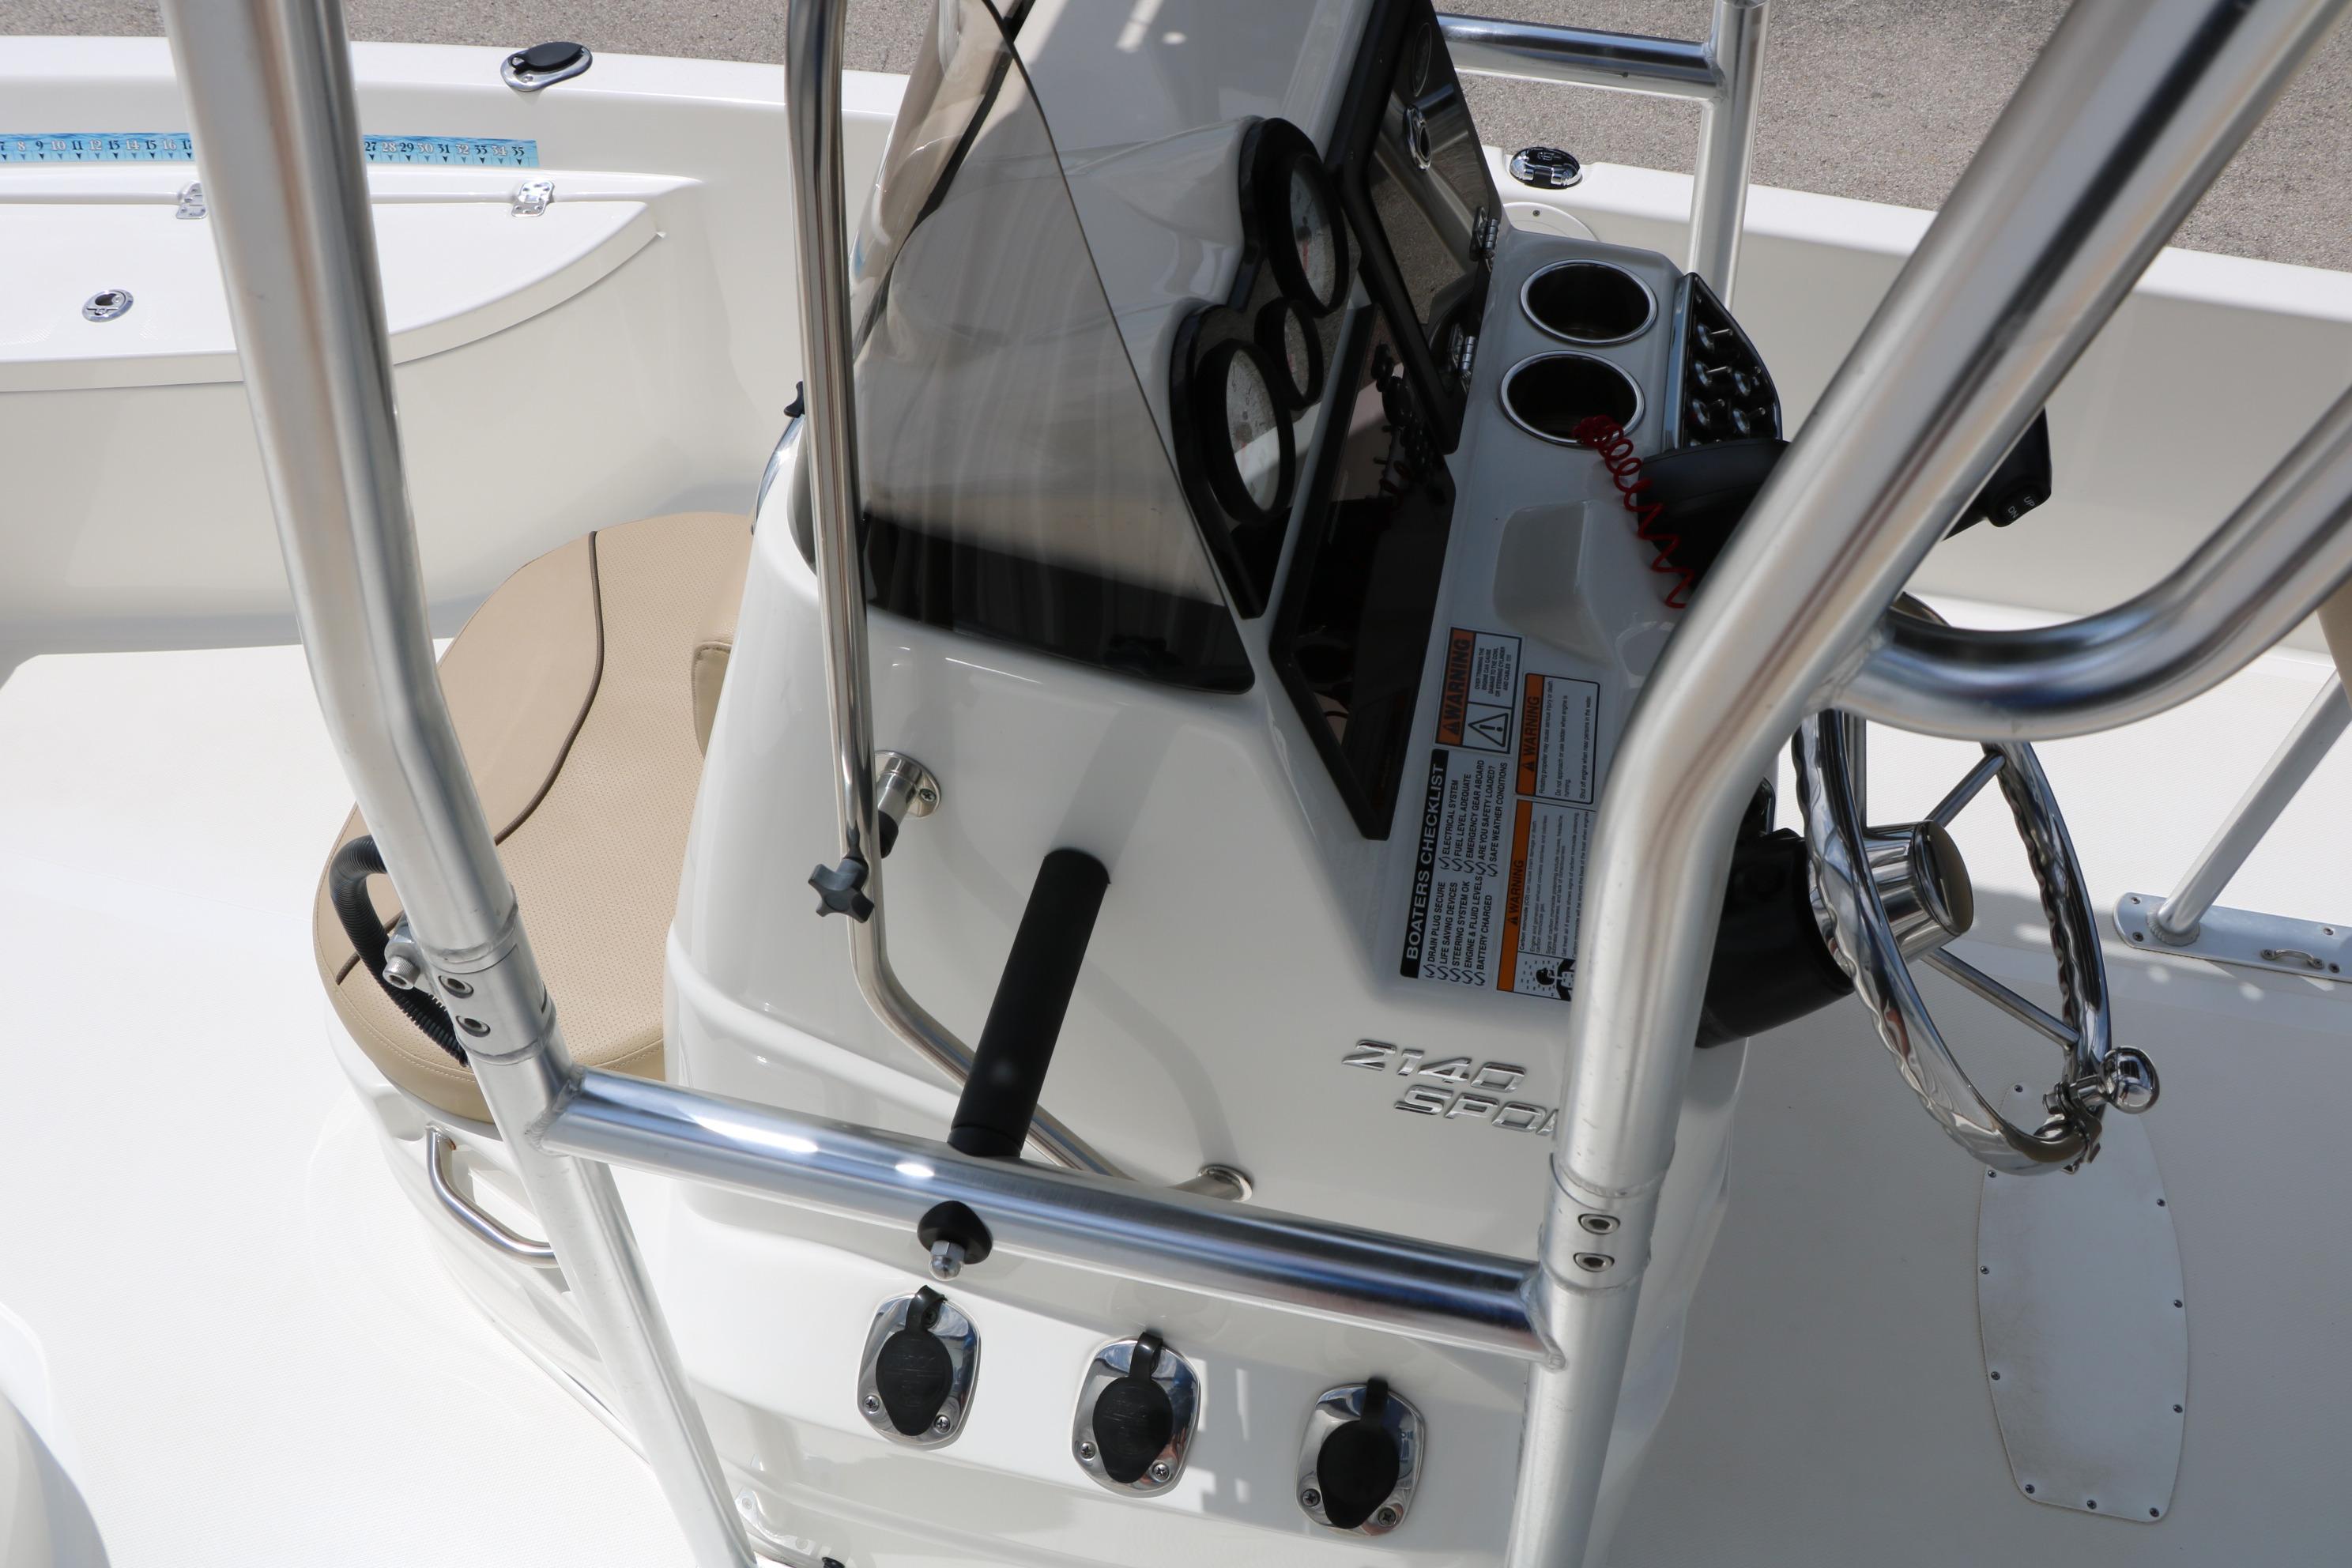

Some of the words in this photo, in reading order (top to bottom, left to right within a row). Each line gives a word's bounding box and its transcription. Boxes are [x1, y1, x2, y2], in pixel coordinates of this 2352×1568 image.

[17, 140, 26, 152] 8
[36, 140, 43, 151] 9
[51, 140, 66, 151] 10
[72, 140, 83, 150] 11
[89, 140, 102, 151] 12
[108, 140, 120, 150] 13
[126, 140, 140, 151] 14
[145, 140, 156, 150] 15
[163, 139, 177, 151] 16
[364, 141, 377, 152] 27
[382, 141, 397, 153] 28
[399, 142, 414, 153] 29
[417, 142, 433, 153] 30
[438, 144, 450, 154] 31
[455, 143, 469, 155] 32
[475, 145, 488, 155] 33
[492, 145, 507, 156] 34
[511, 145, 525, 156] 35
[2007, 506, 2019, 518] DN
[2024, 496, 2036, 507] UP
[1443, 638, 1470, 721] WARNING
[1523, 695, 1540, 756] WARNING
[1475, 760, 1484, 789] ABOARD
[1485, 765, 1495, 797] LOADED?
[1496, 762, 1508, 805] CONDITIONS
[1460, 774, 1472, 811] ADEQUATE
[1472, 790, 1481, 810] GEAR
[1442, 809, 1455, 854] ELECTRICAL
[1449, 779, 1459, 808] SYSTEM
[1457, 813, 1466, 835] LEVEL
[1482, 799, 1491, 827] SAFETY
[1492, 806, 1502, 841] WEATHER
[1454, 838, 1463, 856] FUEL
[1466, 812, 1478, 858] EMERGENCY
[1407, 869, 1429, 959] BOATERS
[1421, 763, 1445, 865] CHECKLIST
[1490, 842, 1498, 861] SAFE
[1434, 881, 1446, 913] SECURE
[1447, 882, 1457, 914] DEVICES
[1462, 880, 1469, 892] OK
[1472, 876, 1482, 905] LEVELS
[1507, 858, 1524, 914] WARNING
[1457, 894, 1468, 925] SYSTEM
[1470, 906, 1479, 929] FLUID
[1481, 895, 1492, 933] CHARGED
[1431, 914, 1441, 936] PLUG
[1442, 916, 1453, 945] SAVING
[1428, 937, 1438, 962] DRAIN
[1440, 947, 1449, 964] LIFE
[1452, 926, 1464, 966] STEERING
[1464, 938, 1475, 967] ENGINE
[1477, 935, 1487, 970] BATTERY
